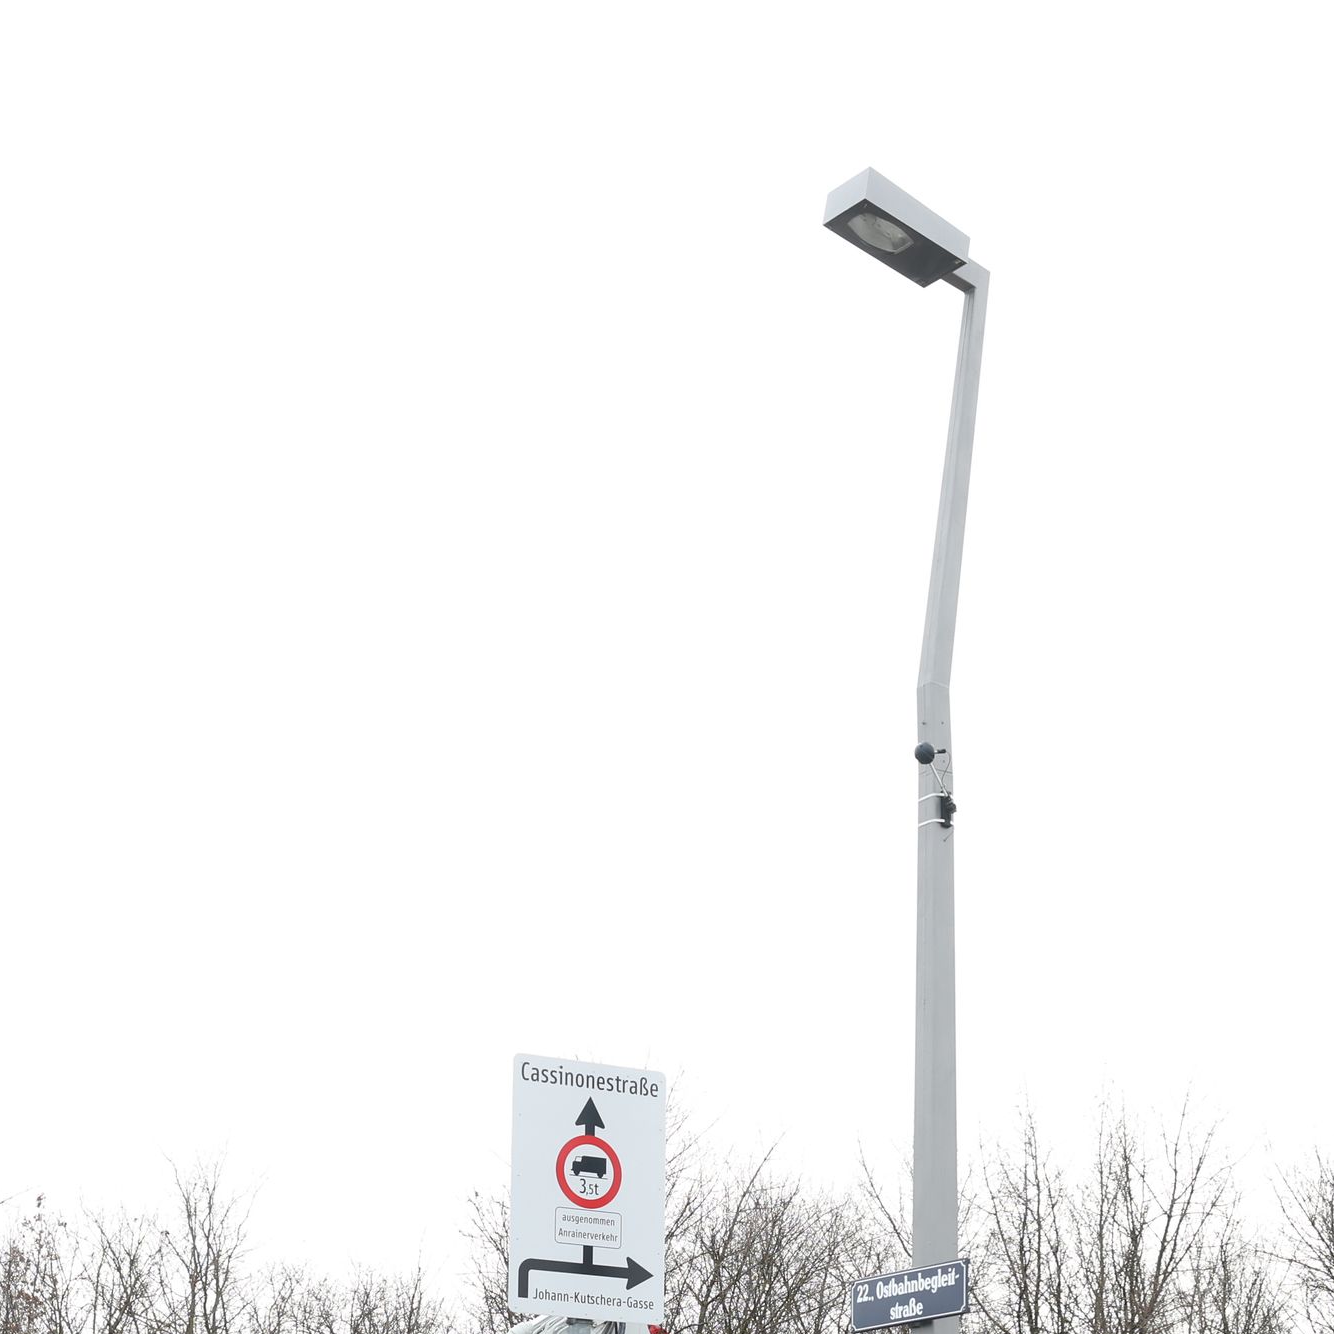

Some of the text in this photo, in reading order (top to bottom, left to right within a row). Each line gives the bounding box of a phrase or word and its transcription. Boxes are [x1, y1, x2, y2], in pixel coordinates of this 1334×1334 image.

[521, 1062, 659, 1097] Cassinonestraße
[562, 1214, 615, 1226] ausgenommen
[558, 1228, 618, 1242] Anrainerverkehr
[876, 1267, 960, 1300] Ostbahnbegleit-
[533, 1288, 654, 1310] Johann-Kutschera-Gasse
[890, 1298, 923, 1320] straße
